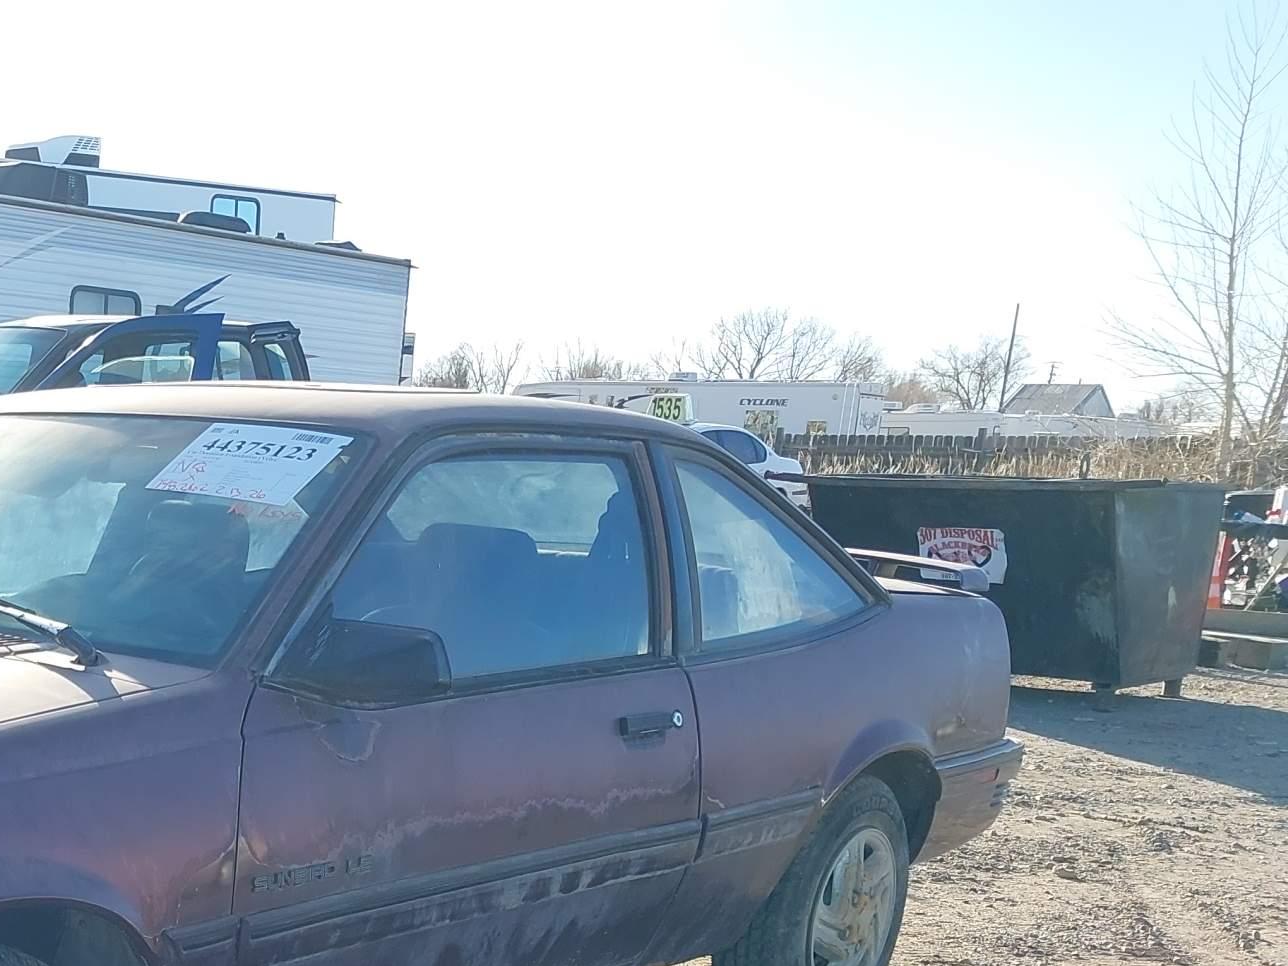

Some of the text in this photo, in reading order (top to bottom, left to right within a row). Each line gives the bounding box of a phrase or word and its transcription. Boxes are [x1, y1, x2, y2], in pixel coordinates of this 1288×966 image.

[652, 397, 682, 420] 1535
[739, 398, 789, 407] CYCLONE
[202, 438, 318, 461] 44375123
[919, 528, 999, 551] 307 DISPOSAL
